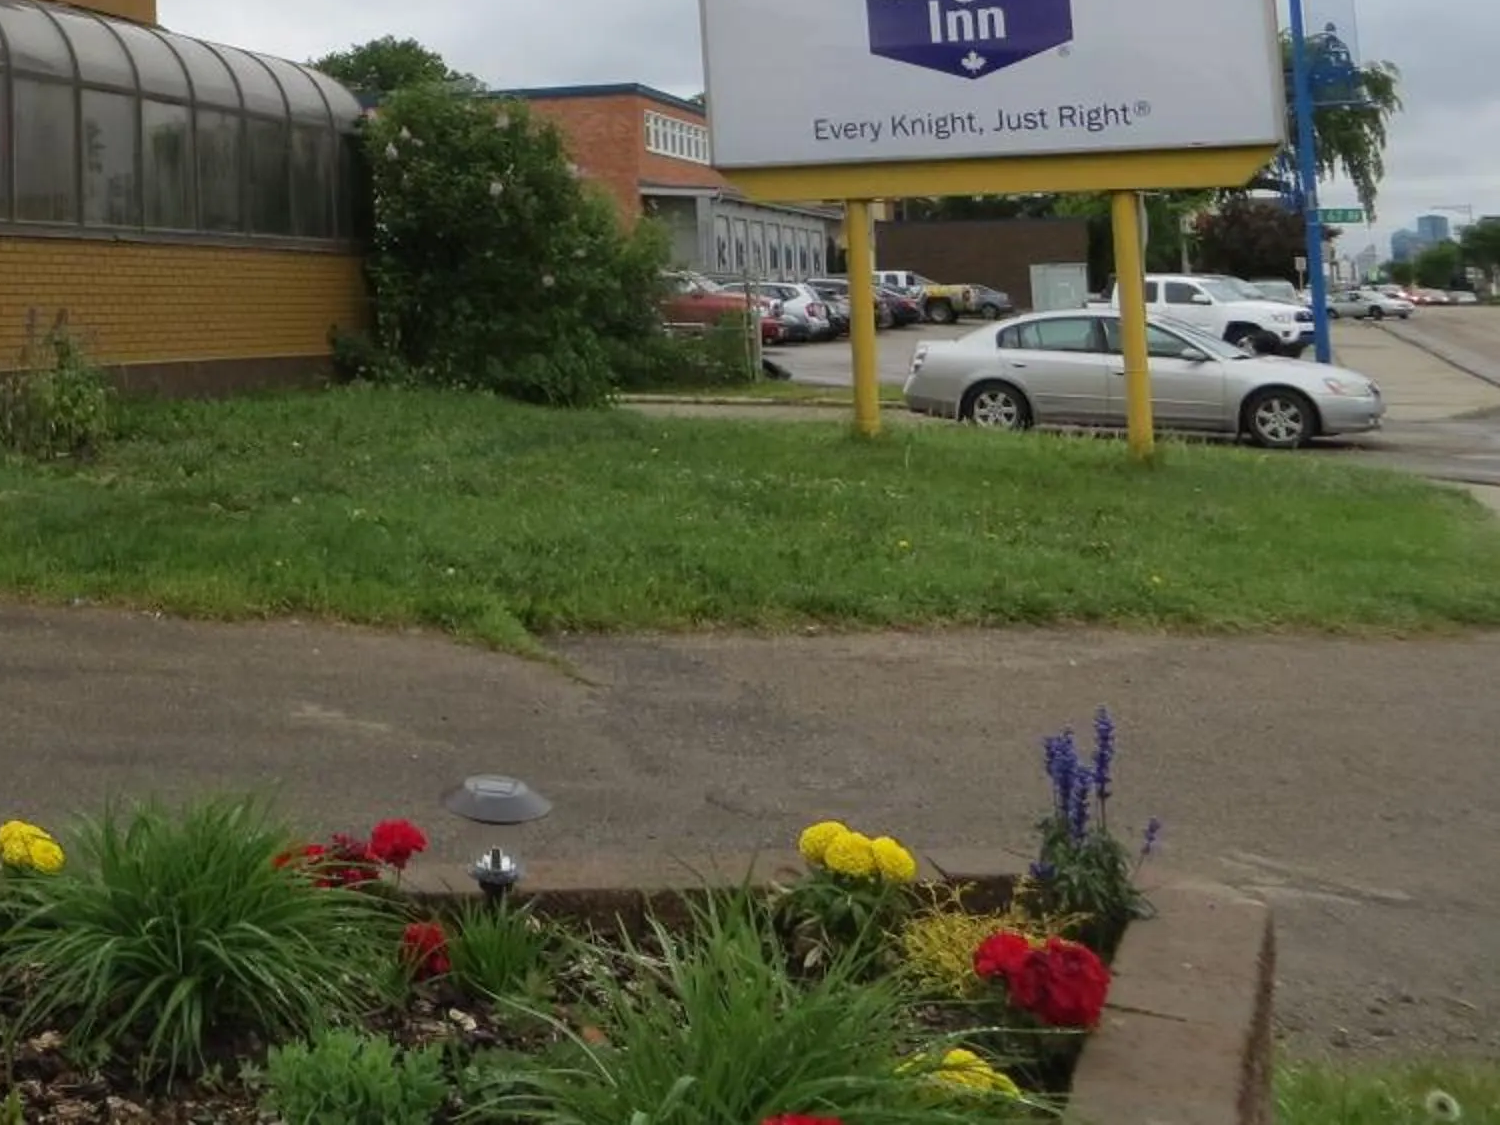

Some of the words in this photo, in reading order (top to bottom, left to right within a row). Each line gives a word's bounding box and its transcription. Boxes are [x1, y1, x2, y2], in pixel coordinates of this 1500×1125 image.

[813, 118, 883, 143] Every
[890, 111, 985, 140] Knight,
[992, 107, 1050, 132] Just
